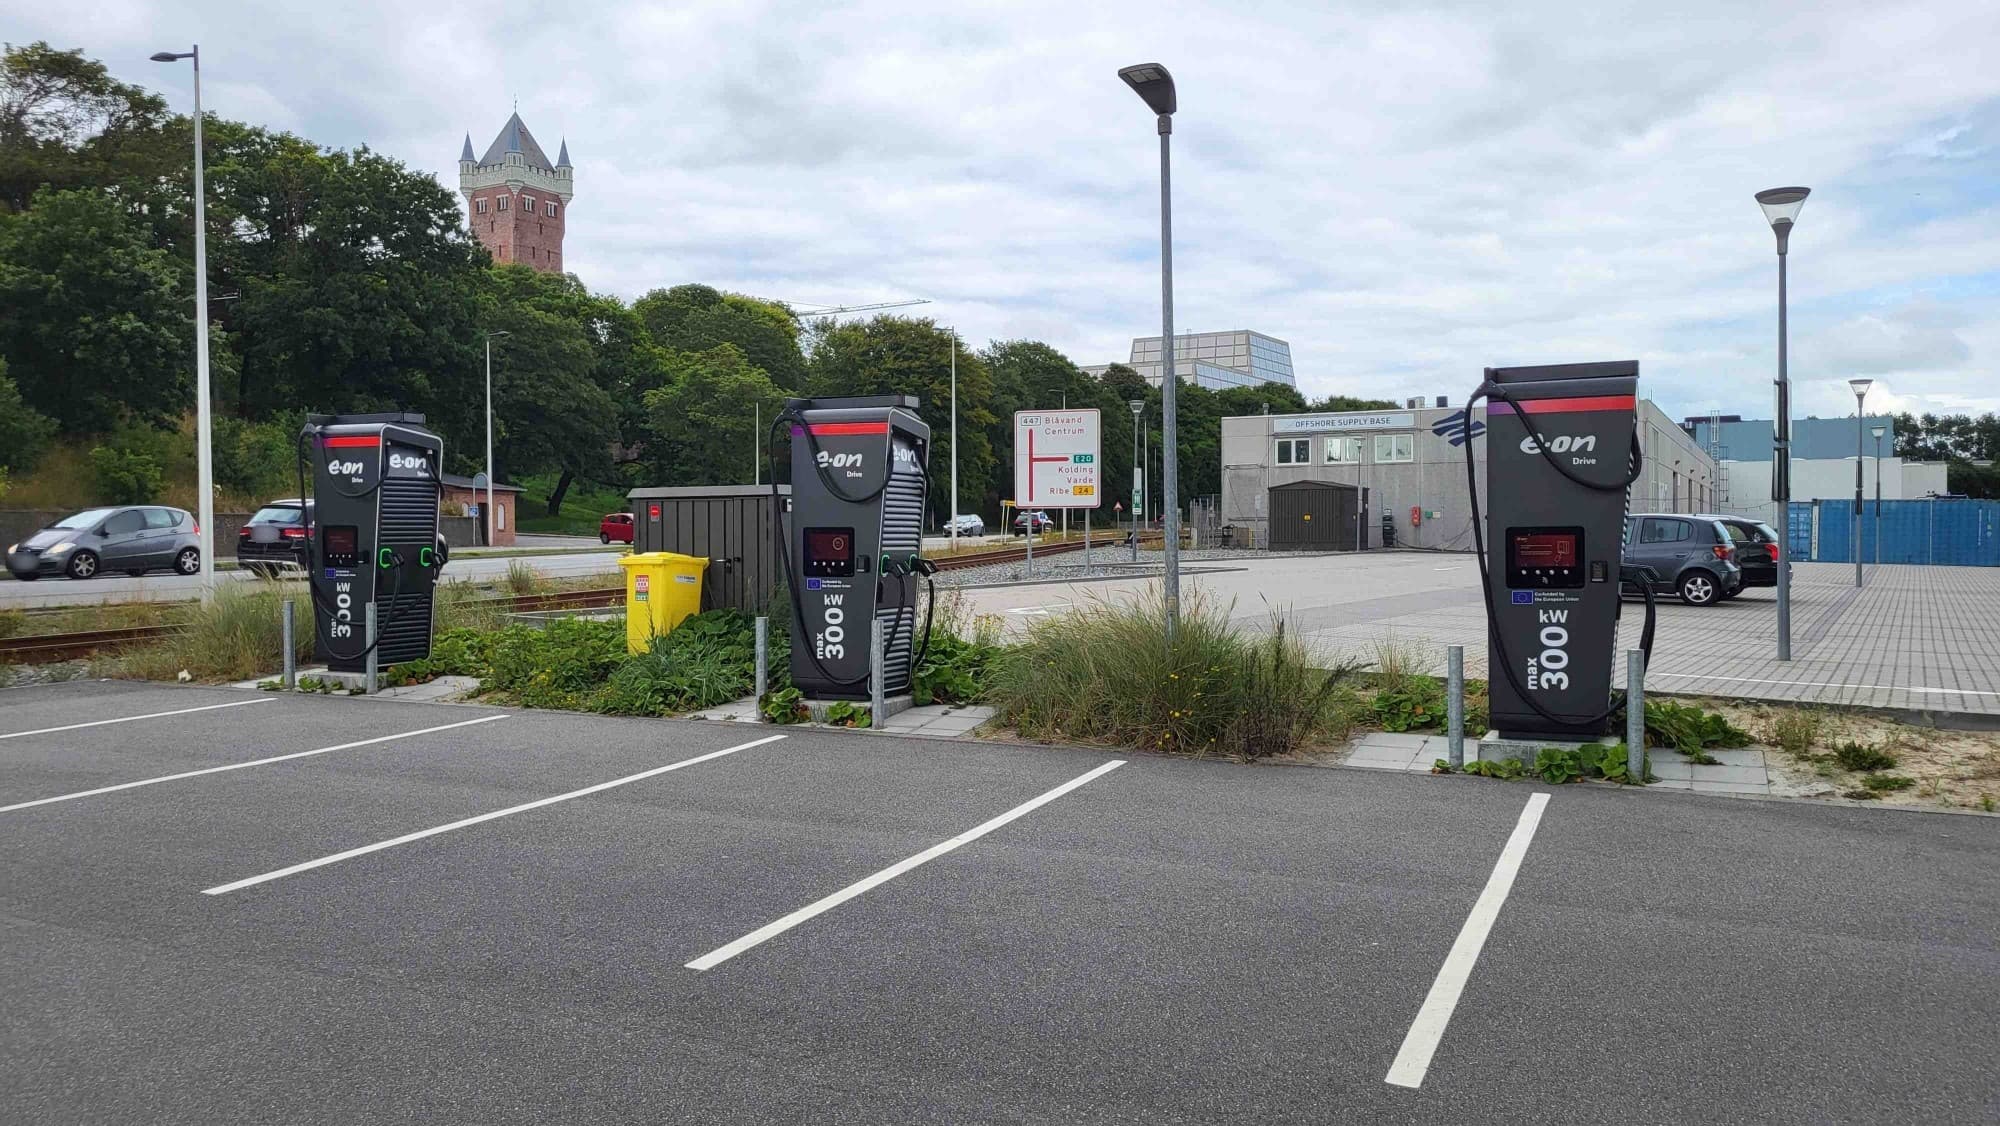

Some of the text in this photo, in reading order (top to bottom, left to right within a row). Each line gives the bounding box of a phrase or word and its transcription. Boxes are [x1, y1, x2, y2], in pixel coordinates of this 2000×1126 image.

[1045, 416, 1082, 424] Blåvand
[1295, 416, 1391, 428] OFFSHORE SUPPLY BASE
[1572, 457, 1596, 465] Drive
[1058, 466, 1094, 474] Kolding
[1067, 476, 1094, 484] Varde
[336, 582, 351, 593] kW
[824, 594, 843, 606] kW
[337, 593, 351, 638] 300
[1539, 609, 1568, 623] kW
[824, 607, 844, 659] 300
[816, 632, 824, 659] max
[1540, 626, 1569, 690] 300
[1527, 657, 1538, 690] max
